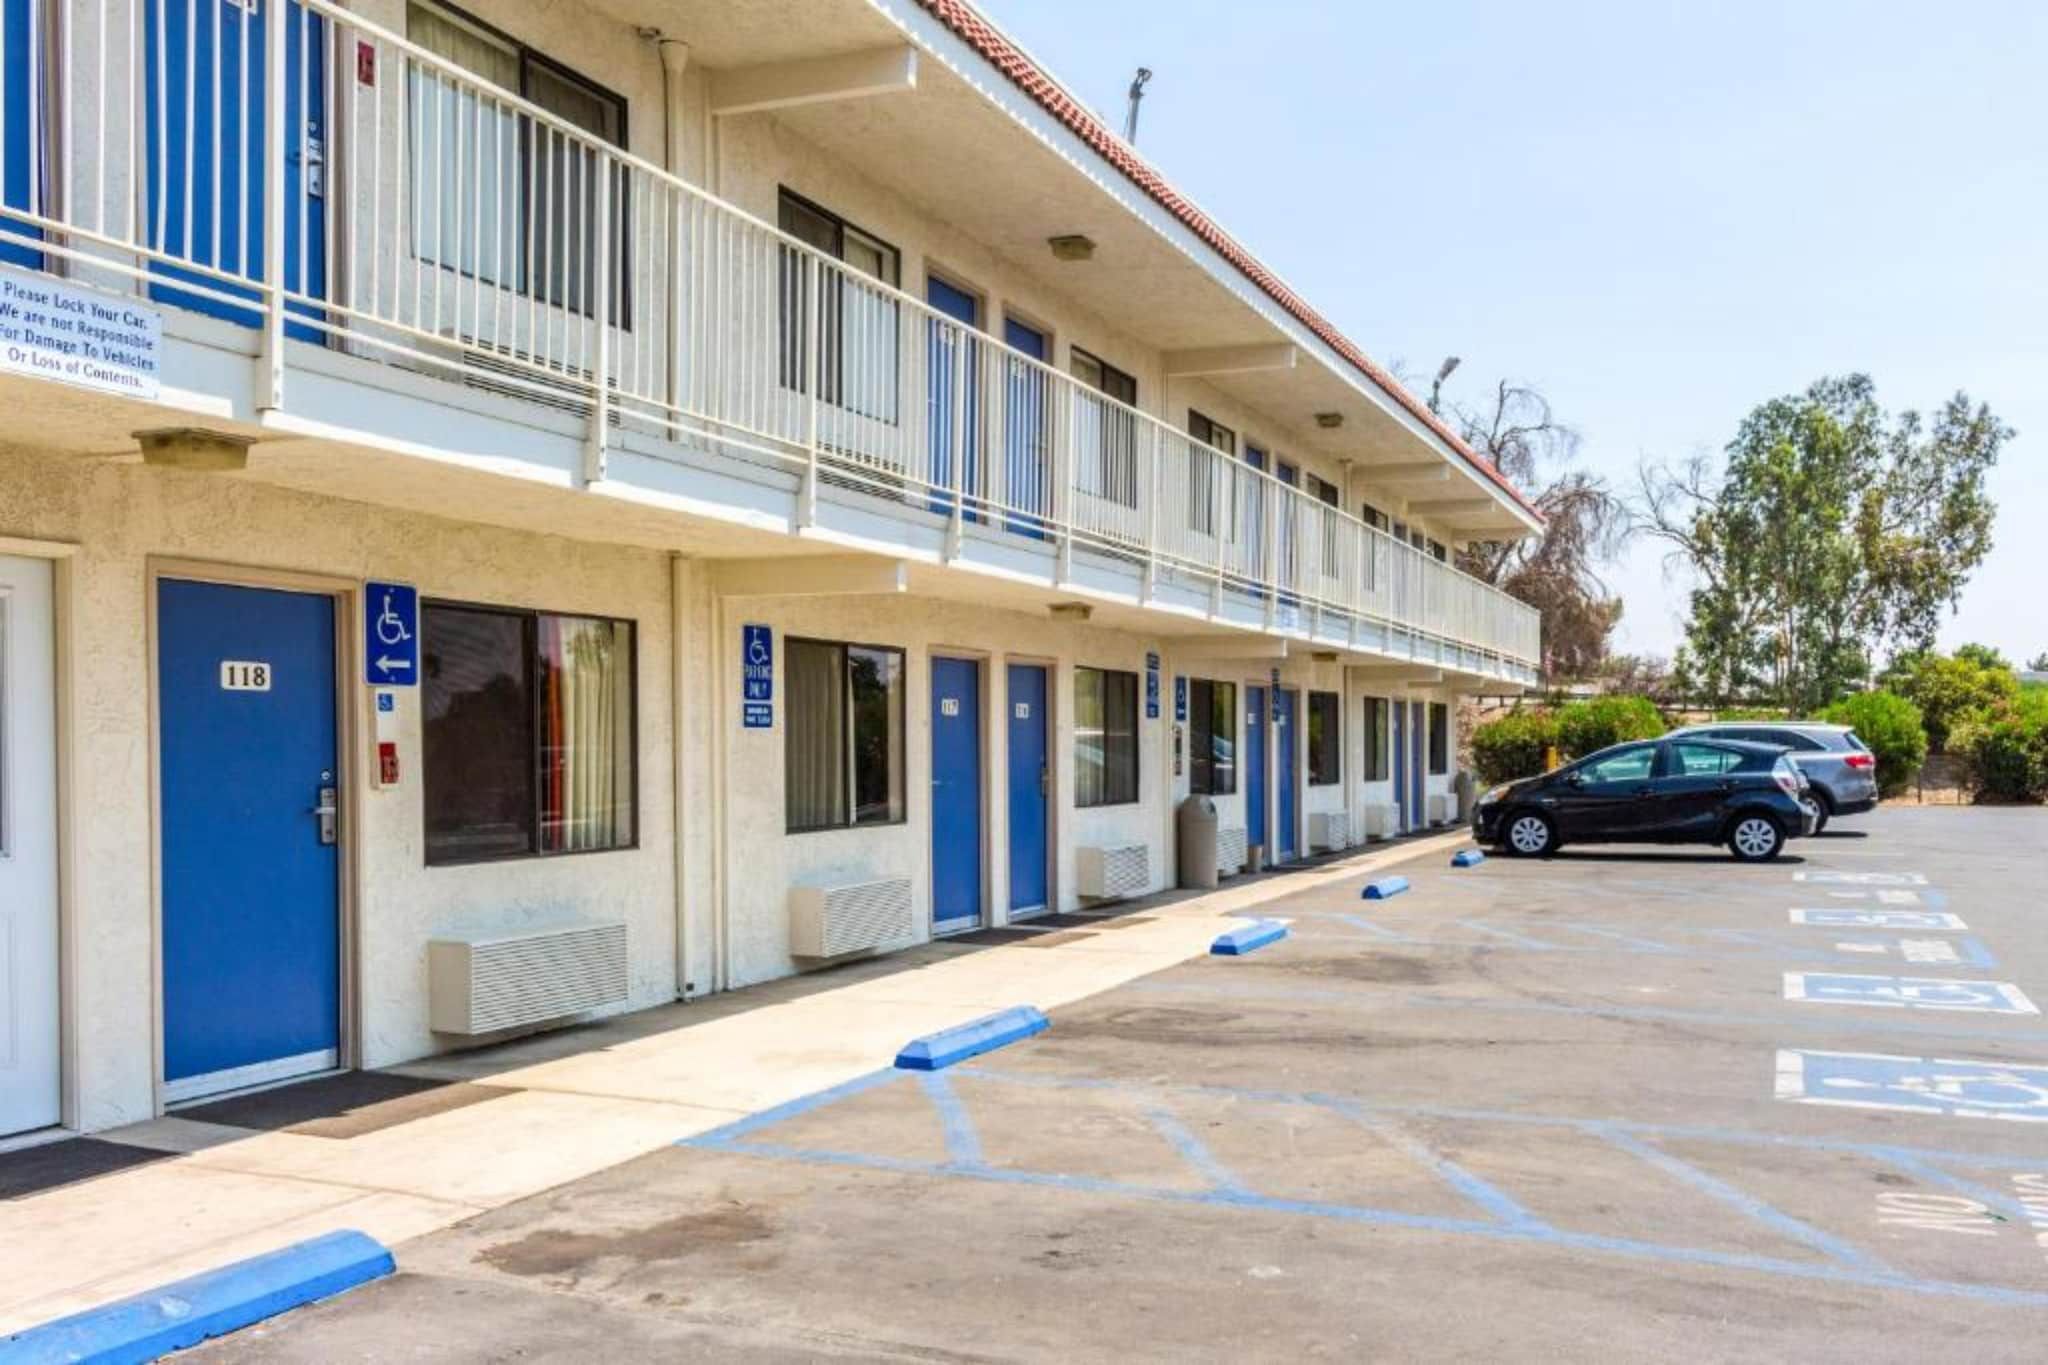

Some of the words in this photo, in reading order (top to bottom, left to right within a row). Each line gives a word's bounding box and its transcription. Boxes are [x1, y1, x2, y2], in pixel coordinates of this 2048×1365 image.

[4, 281, 48, 305] Please
[54, 293, 85, 314] Lock
[90, 303, 118, 321] Your
[0, 302, 19, 319] We
[23, 310, 46, 325] are
[51, 317, 73, 330] not
[77, 321, 153, 350] Responsible
[7, 347, 26, 363] Or
[32, 352, 61, 371] Loss
[66, 360, 79, 374] of
[25, 329, 77, 354] Damage
[83, 342, 99, 358] To
[103, 350, 154, 371] Vehicles
[228, 665, 266, 686] 118
